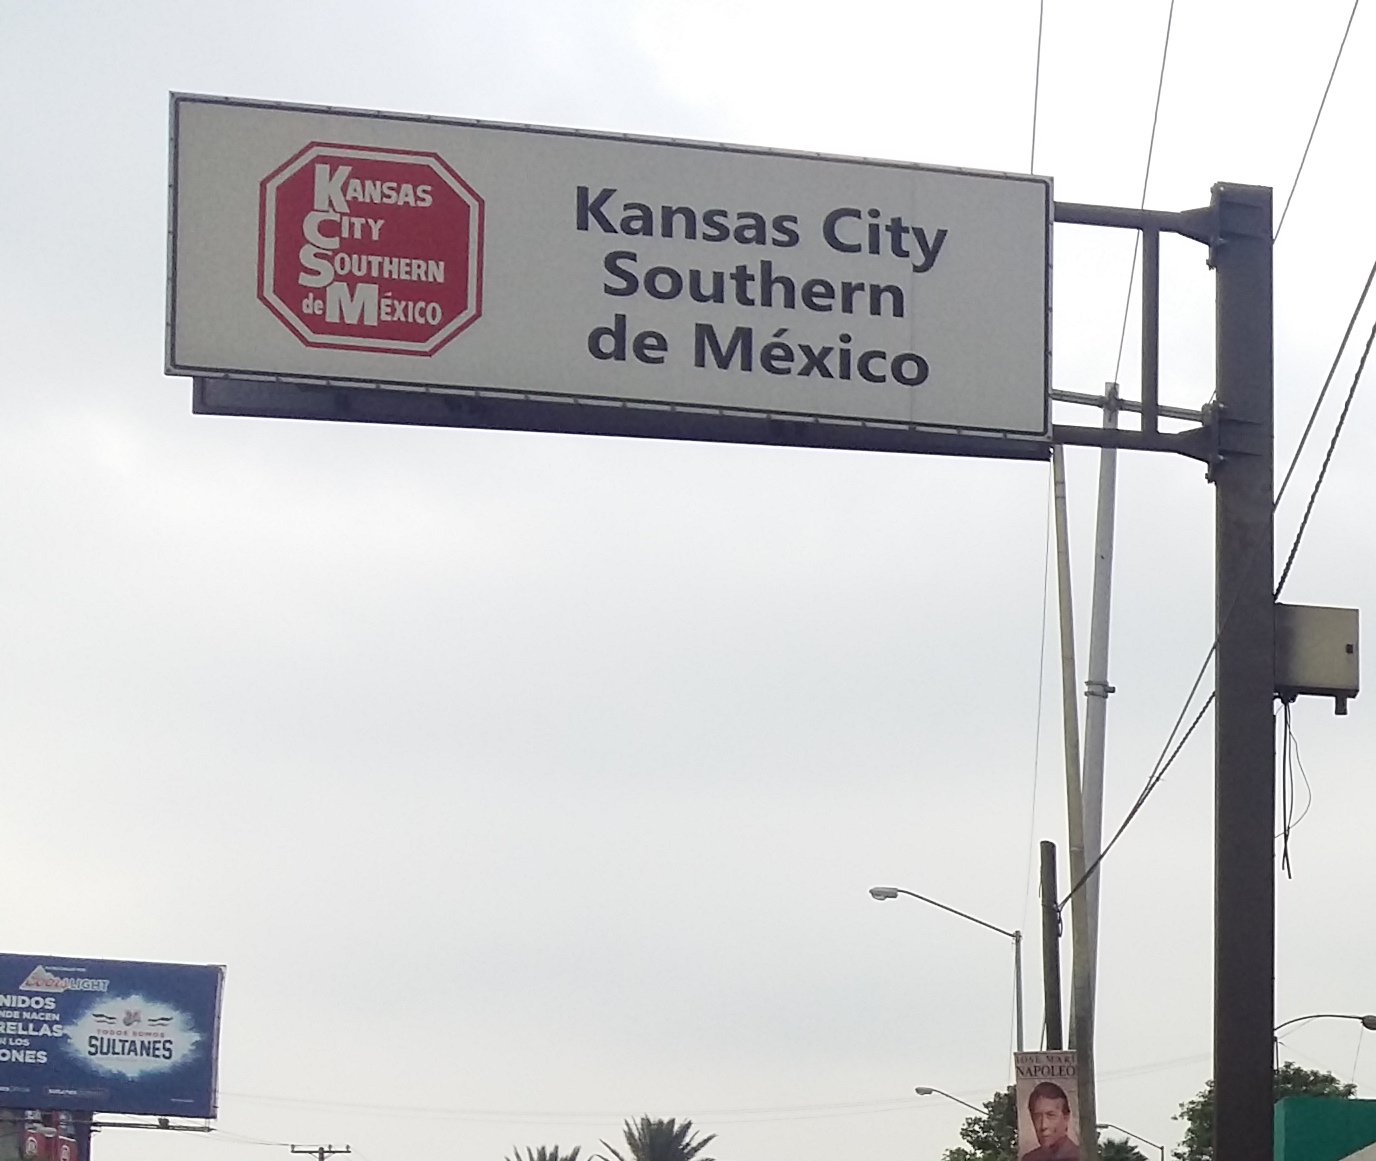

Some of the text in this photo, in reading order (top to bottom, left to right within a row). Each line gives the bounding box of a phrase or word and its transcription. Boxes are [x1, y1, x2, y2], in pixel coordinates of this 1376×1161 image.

[314, 163, 433, 213] KANSAS
[302, 211, 385, 250] CITY
[575, 185, 949, 273] Kansas City
[298, 243, 445, 288] SOUTHERN
[603, 249, 905, 318] Southern
[302, 293, 325, 315] de
[587, 313, 930, 387] de México
[70, 978, 110, 992] LIGHT
[23, 1011, 60, 1021] NACEN
[9, 1038, 30, 1047] LOS
[88, 1036, 173, 1059] SULTANES
